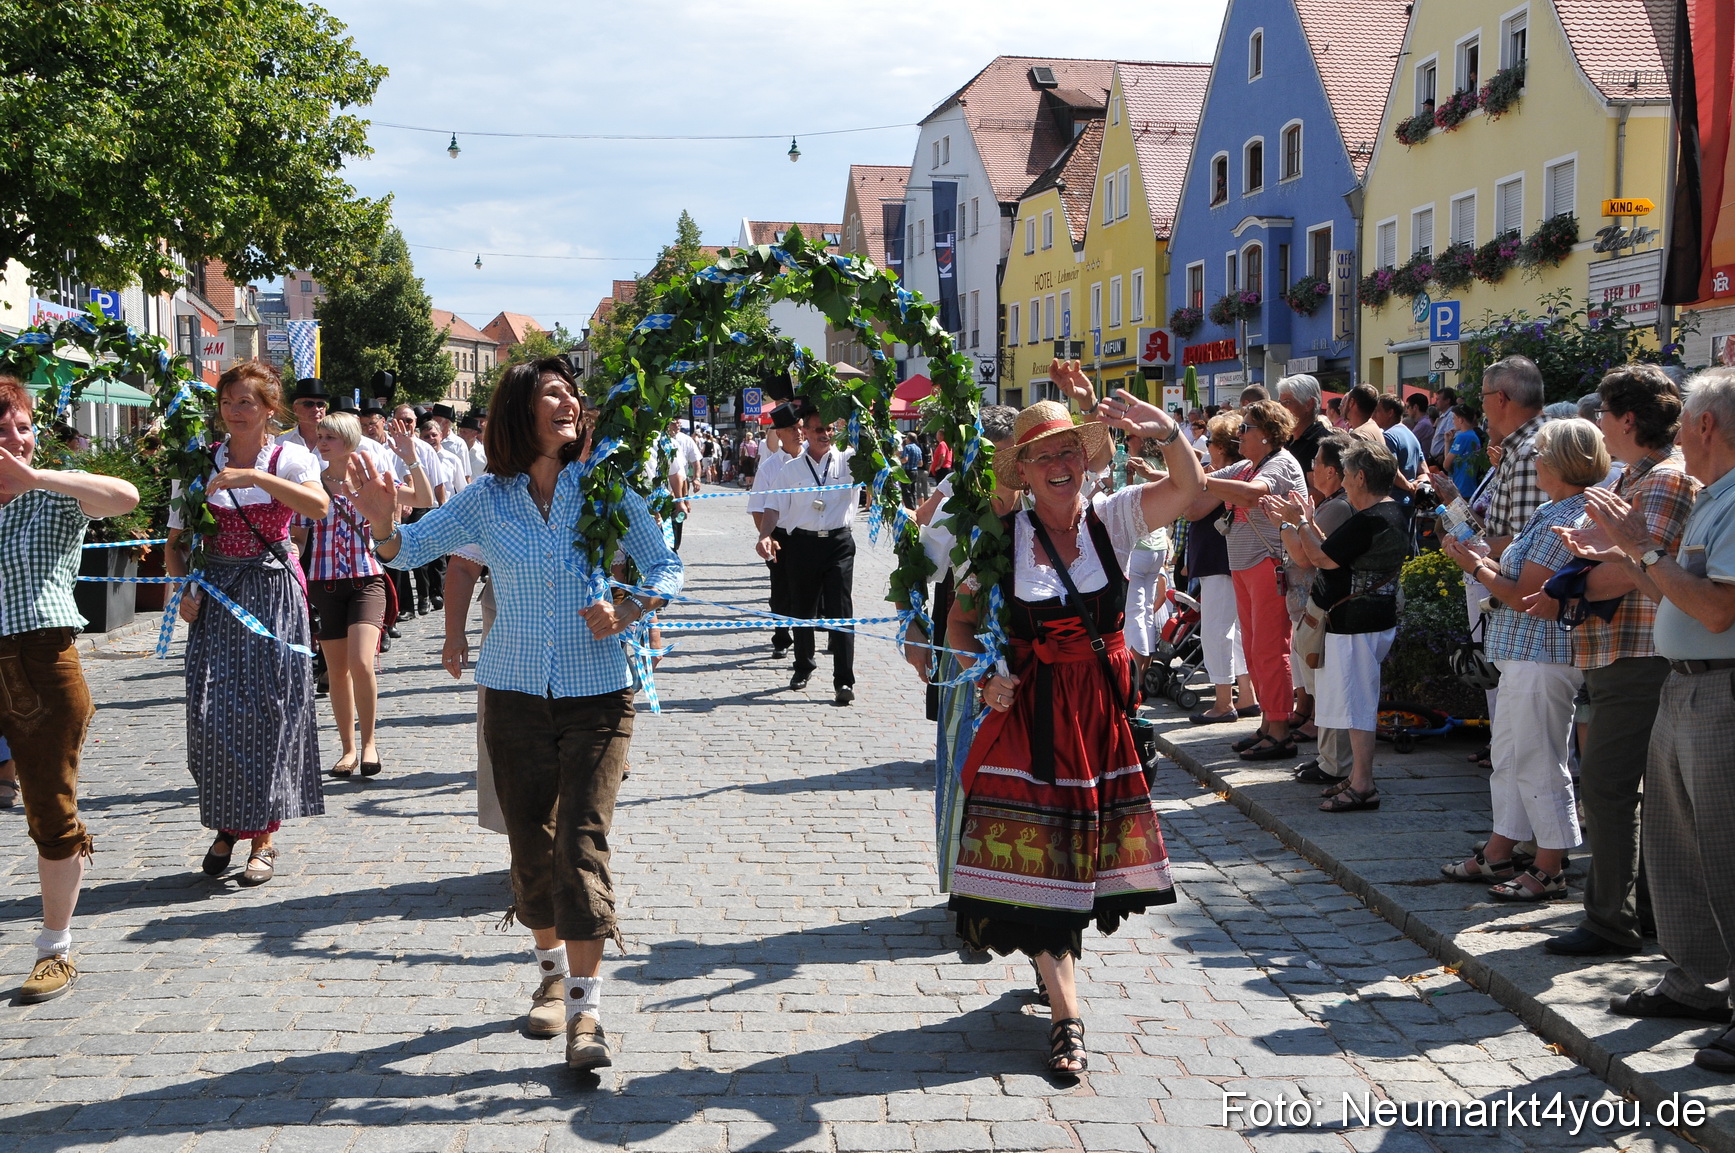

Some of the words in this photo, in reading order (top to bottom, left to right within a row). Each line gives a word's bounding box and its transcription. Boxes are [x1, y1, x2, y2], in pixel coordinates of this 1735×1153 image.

[1610, 202, 1633, 212] KINO
[936, 233, 953, 278] K&L
[1035, 271, 1053, 291] HOTEL
[97, 293, 114, 309] P
[1337, 268, 1351, 333] WITTL
[1603, 286, 1624, 302] STEP
[1629, 284, 1641, 298] UP
[1437, 306, 1454, 337] P
[203, 342, 224, 356] H&M
[1094, 331, 1099, 353] P
[1182, 339, 1236, 366] APOTHEKE
